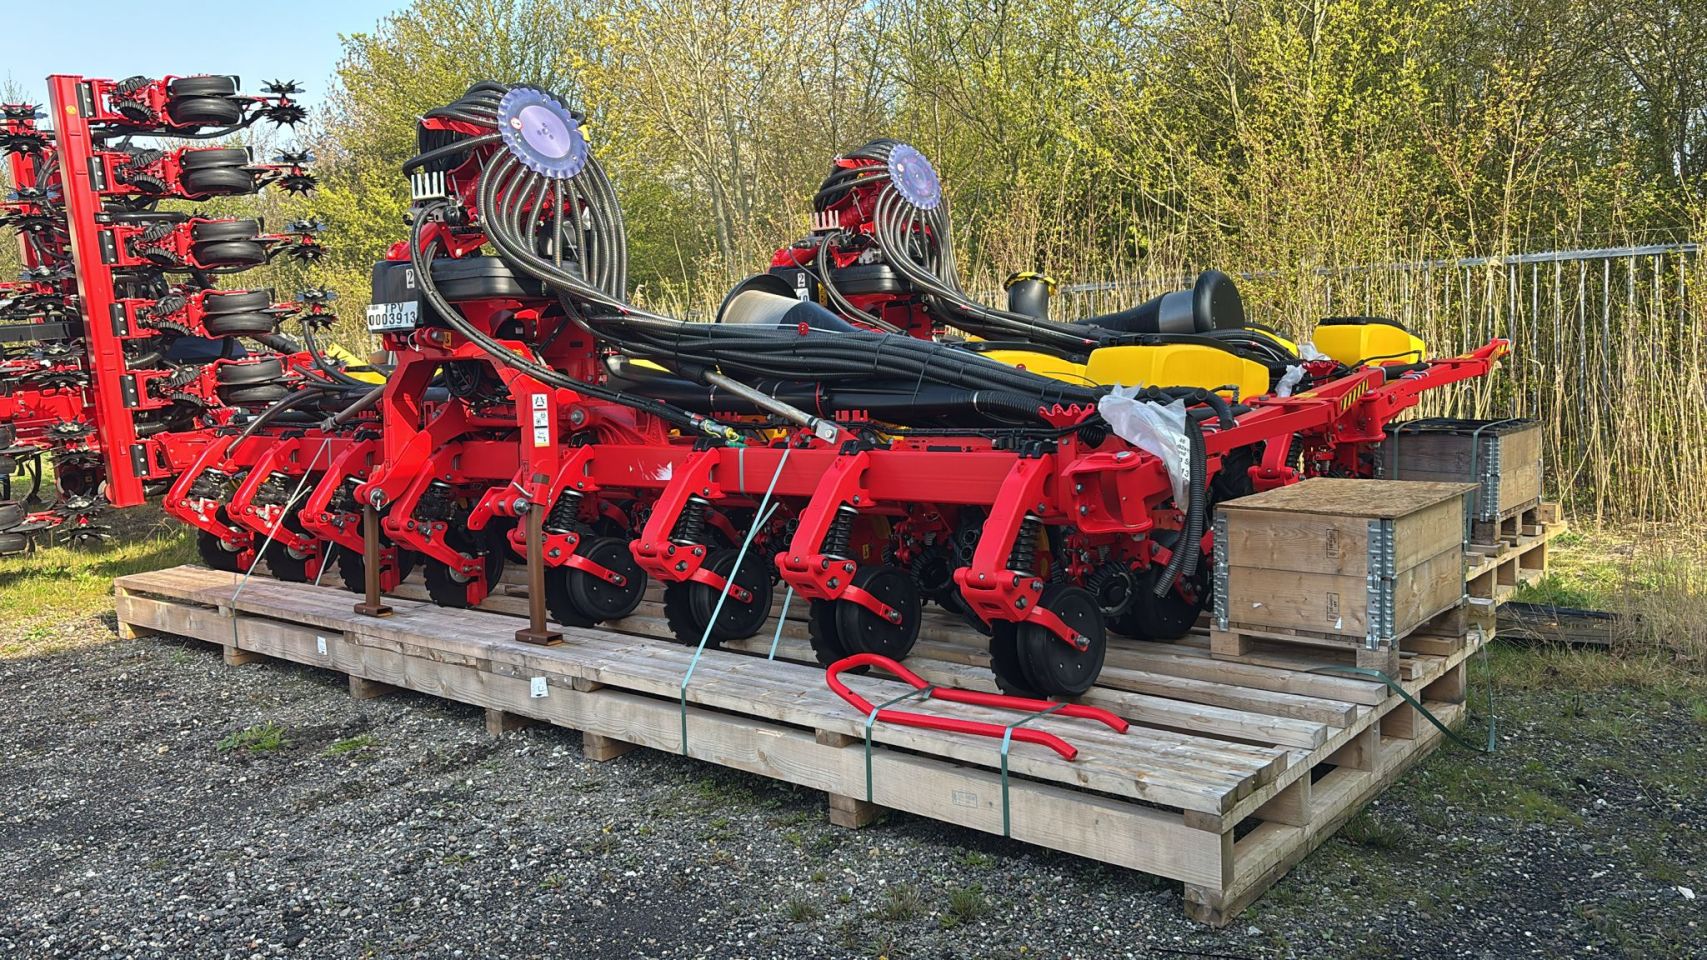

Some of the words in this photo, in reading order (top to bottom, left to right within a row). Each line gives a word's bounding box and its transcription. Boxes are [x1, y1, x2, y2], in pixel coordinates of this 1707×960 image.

[407, 270, 413, 284] 2
[798, 273, 804, 284] 2
[384, 303, 403, 313] TPV
[368, 311, 415, 326] 0003913
